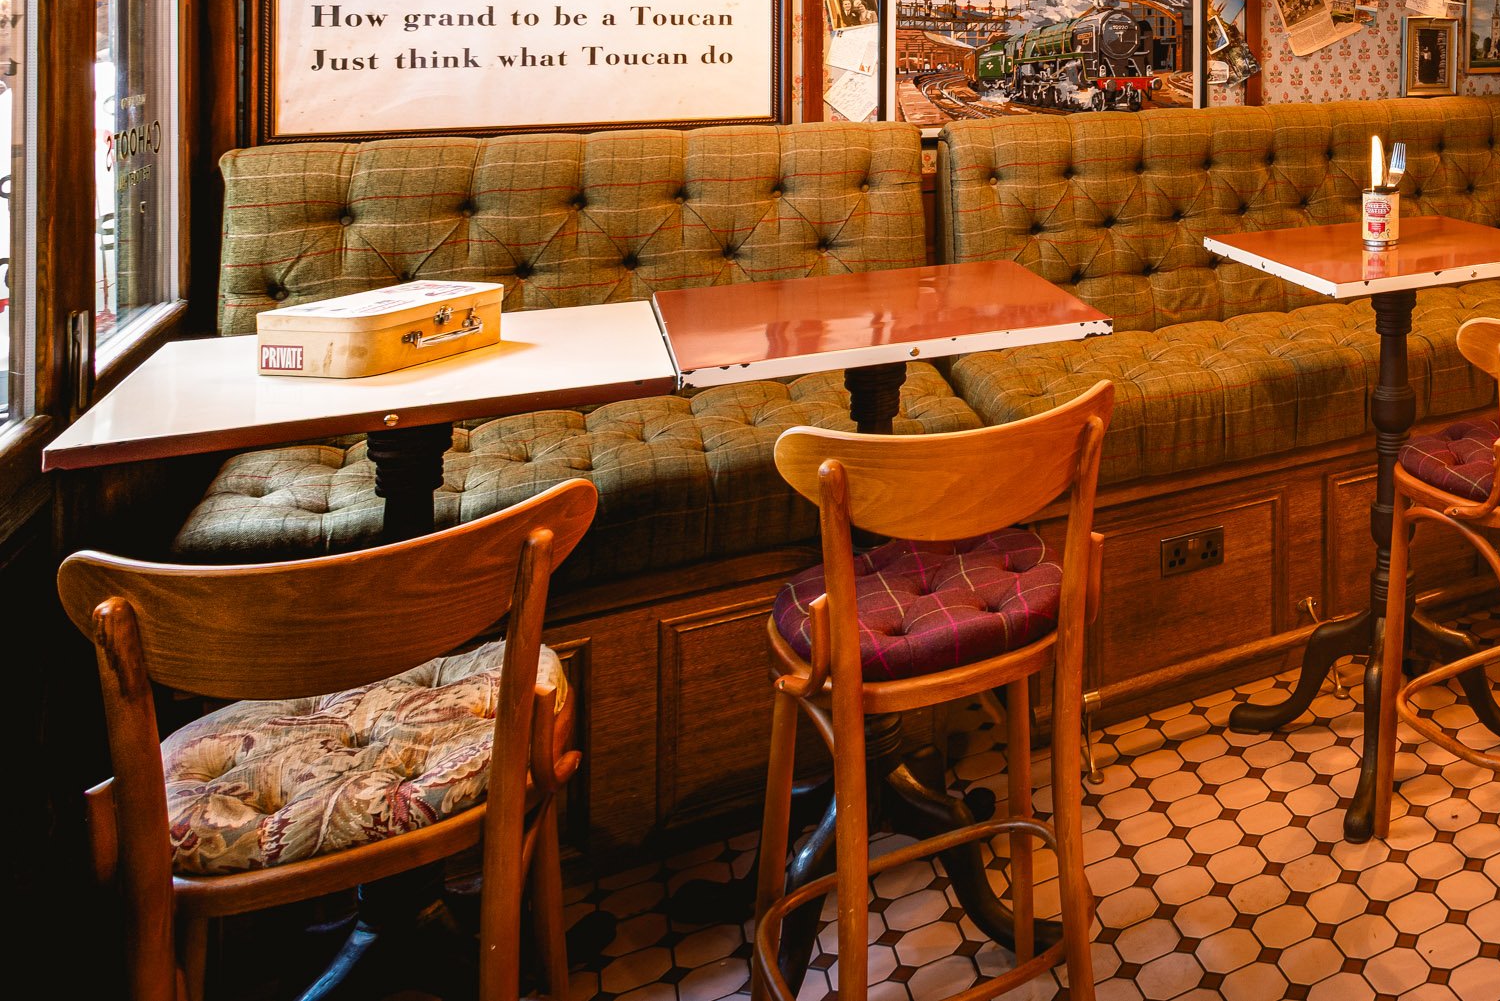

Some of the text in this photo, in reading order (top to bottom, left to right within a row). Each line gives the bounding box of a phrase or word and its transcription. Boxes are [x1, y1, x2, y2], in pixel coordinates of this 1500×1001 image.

[311, 5, 734, 32] How grand to be a Toucan
[311, 45, 734, 72] Just think what Toucan do
[262, 347, 303, 370] PRIVATE
